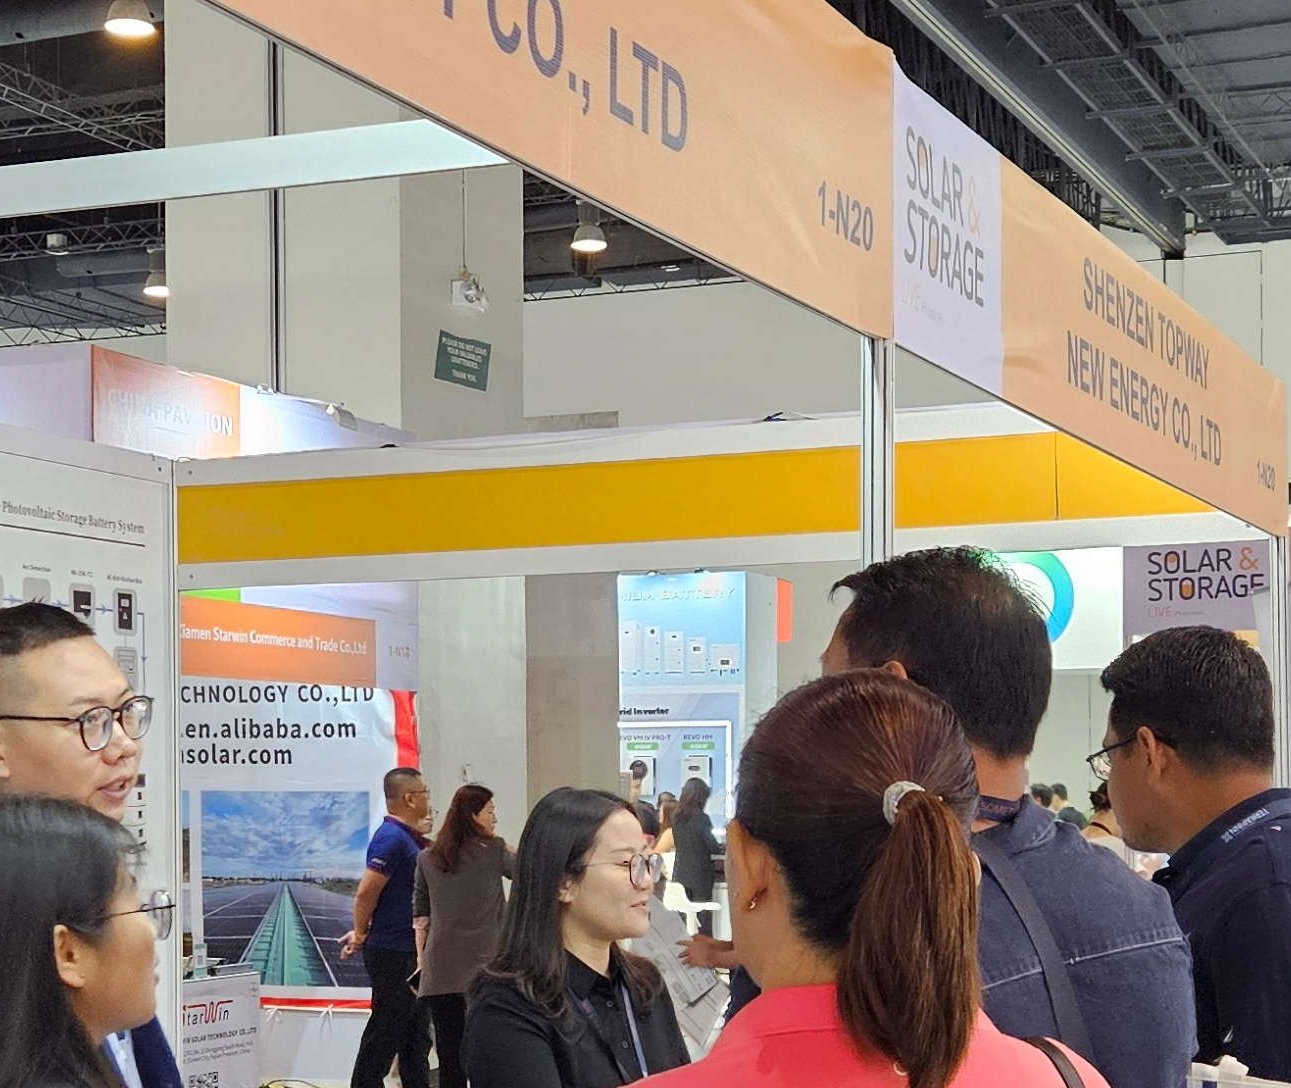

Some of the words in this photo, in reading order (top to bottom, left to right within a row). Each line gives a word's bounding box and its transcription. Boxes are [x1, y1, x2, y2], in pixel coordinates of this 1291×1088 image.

[610, 27, 688, 152] LTD
[906, 126, 963, 227] SOLAR
[967, 176, 981, 239] &
[818, 181, 873, 252] 1-N20
[904, 199, 984, 307] STORAGE
[1083, 257, 1154, 353] SHENZEN
[1158, 311, 1210, 390] TOPWAY
[1067, 330, 1105, 401] NEW
[1110, 356, 1169, 436] ENERGY
[1172, 397, 1198, 461] CO.,
[1200, 415, 1222, 467] LTD
[1256, 459, 1276, 492] 1-N20
[2, 501, 56, 521] Photovoltaic
[57, 509, 88, 528] Storage
[88, 515, 117, 533] Battery
[118, 519, 145, 535] System
[1148, 548, 1232, 575] SOLAR
[1239, 546, 1258, 571] &
[1148, 573, 1265, 602] STORAGE
[1148, 606, 1172, 618] LIVE
[213, 626, 249, 644] Starwin
[249, 630, 296, 648] Commerce
[297, 635, 314, 650] and
[315, 637, 338, 652] Trade
[298, 684, 375, 707] CO.,LTD
[635, 707, 670, 716] Inverter
